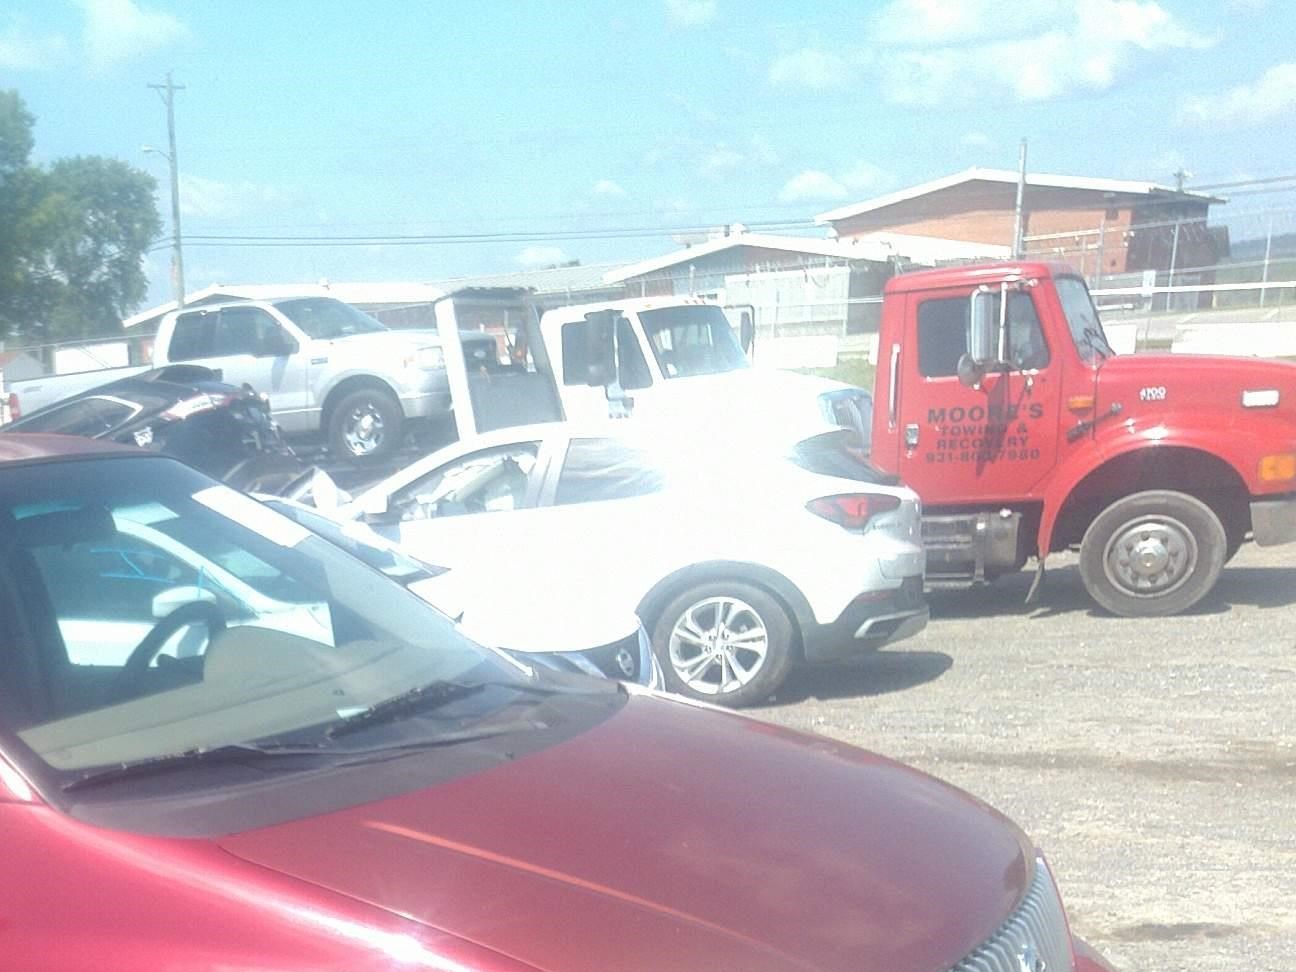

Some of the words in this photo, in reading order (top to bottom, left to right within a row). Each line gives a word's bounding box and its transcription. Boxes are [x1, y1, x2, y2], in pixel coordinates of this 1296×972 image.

[927, 403, 1043, 423] MOORE'S
[939, 424, 1007, 436] TOWING
[936, 435, 1029, 450] RECOVERY
